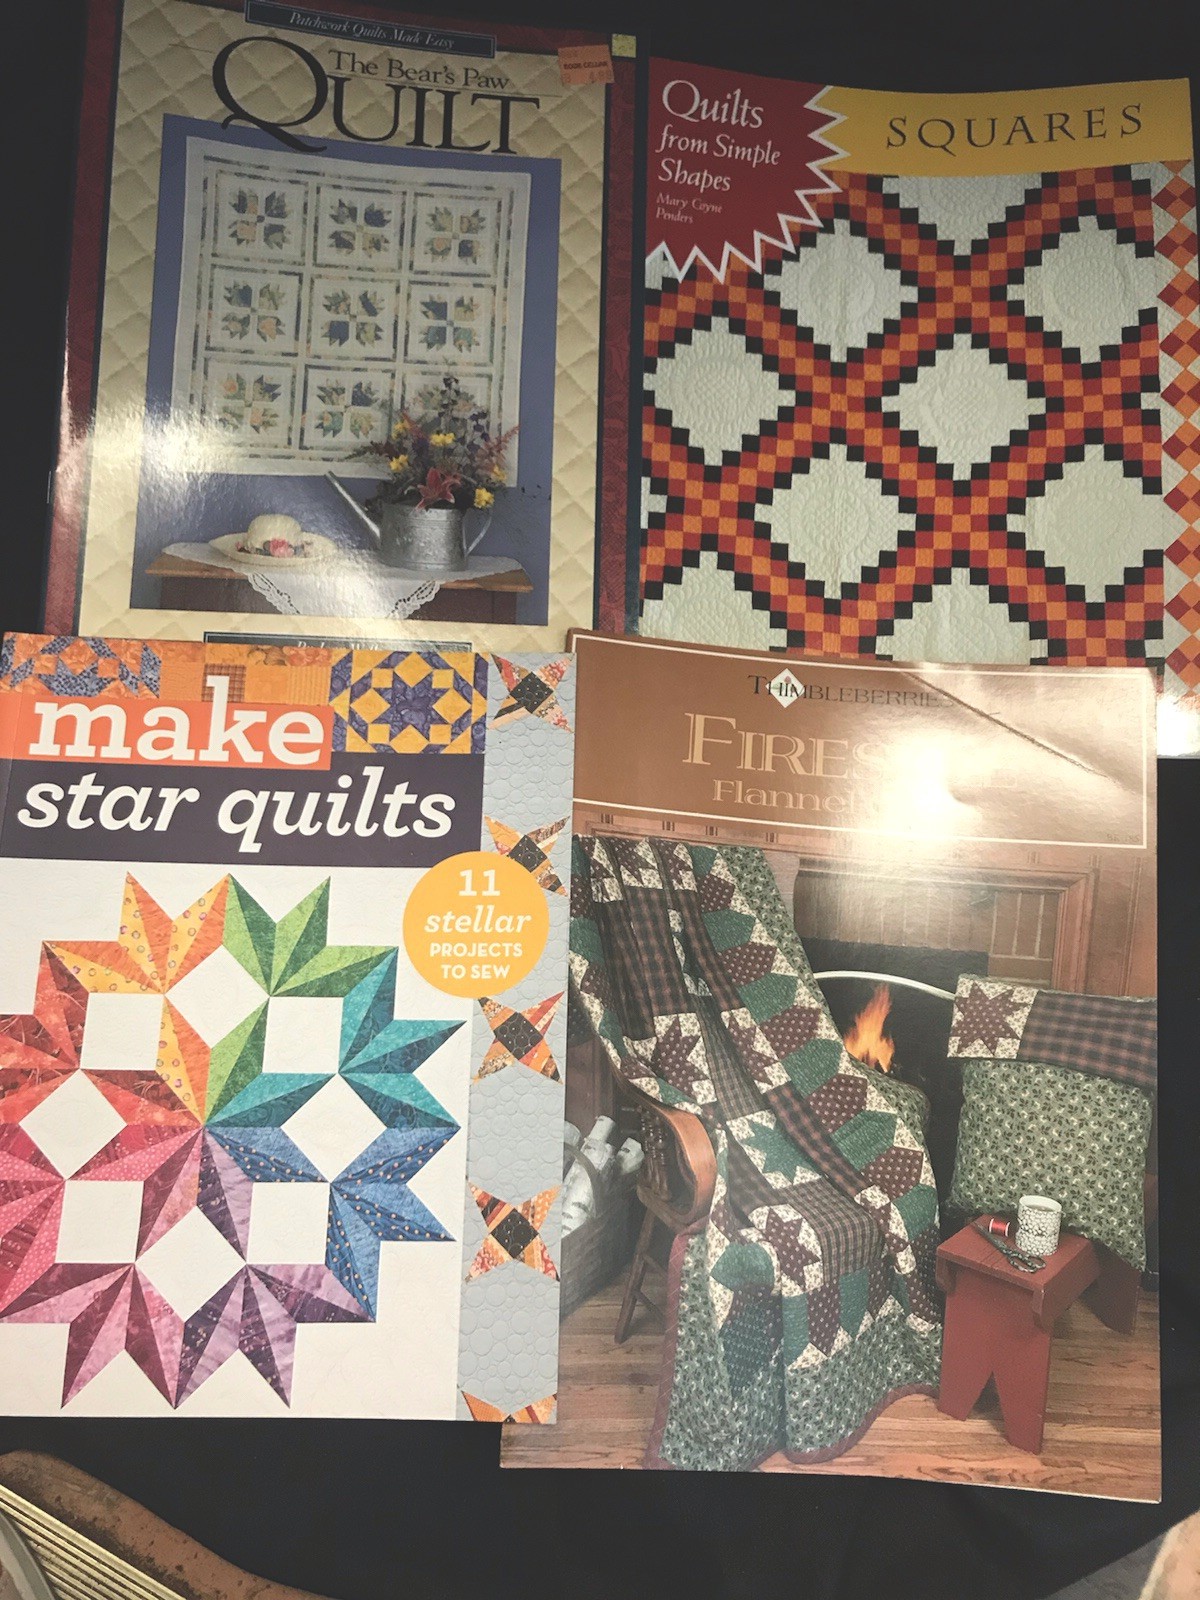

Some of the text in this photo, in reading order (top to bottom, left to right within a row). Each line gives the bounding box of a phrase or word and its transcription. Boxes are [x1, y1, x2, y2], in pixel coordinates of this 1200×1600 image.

[289, 12, 455, 50] Patchwork Quilts Made Easy
[329, 49, 511, 90] The Bear's Paw
[212, 36, 541, 155] QUILT
[662, 80, 765, 128] Quilts
[655, 124, 781, 168] from Simple
[886, 103, 1143, 157] SQUARES
[658, 158, 732, 193] Shapes
[656, 193, 723, 214] Mary Coyne
[656, 207, 694, 224] Penders
[28, 676, 325, 765] make
[17, 765, 456, 853] star quilts
[458, 869, 501, 897] 11
[424, 905, 532, 933] stellar
[430, 942, 523, 958] PROJECTS
[441, 964, 510, 980] TO SEW
